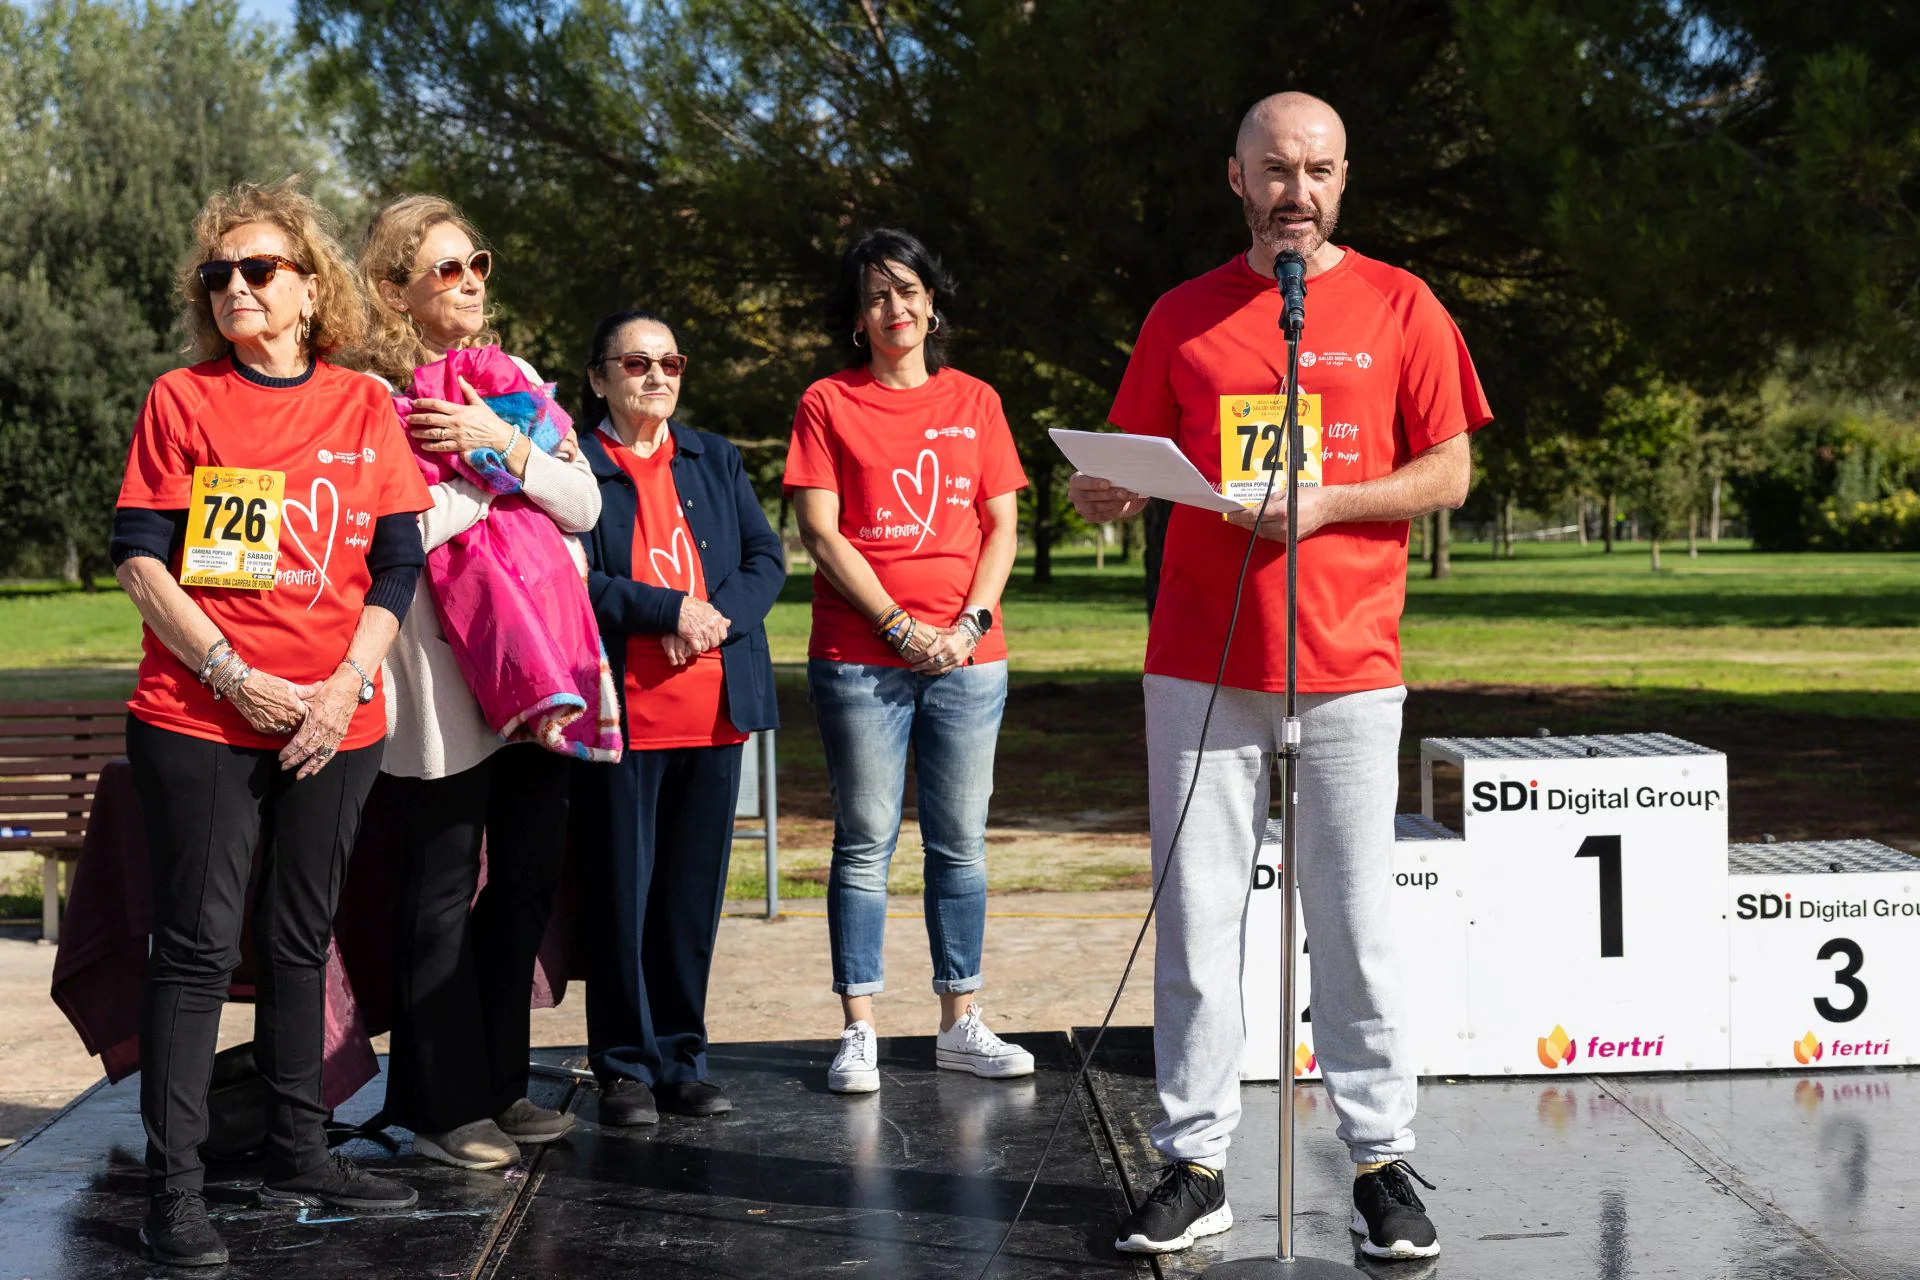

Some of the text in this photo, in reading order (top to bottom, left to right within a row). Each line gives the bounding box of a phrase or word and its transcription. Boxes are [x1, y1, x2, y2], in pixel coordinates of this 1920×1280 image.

[1328, 420, 1360, 441] VIDA
[203, 495, 268, 543] 726
[876, 507, 892, 521] Con
[885, 523, 920, 539] MENTAL
[183, 575, 190, 584] LA
[190, 576, 204, 585] SALUD
[231, 579, 251, 587] CARRERA
[252, 580, 258, 588] DE
[258, 580, 273, 589] FONDO
[1472, 780, 1720, 814] SDi Digital Group
[1574, 834, 1624, 958] 1
[1736, 893, 1792, 920] SDi
[1800, 900, 1867, 922] Digital
[1813, 937, 1869, 1023] 3
